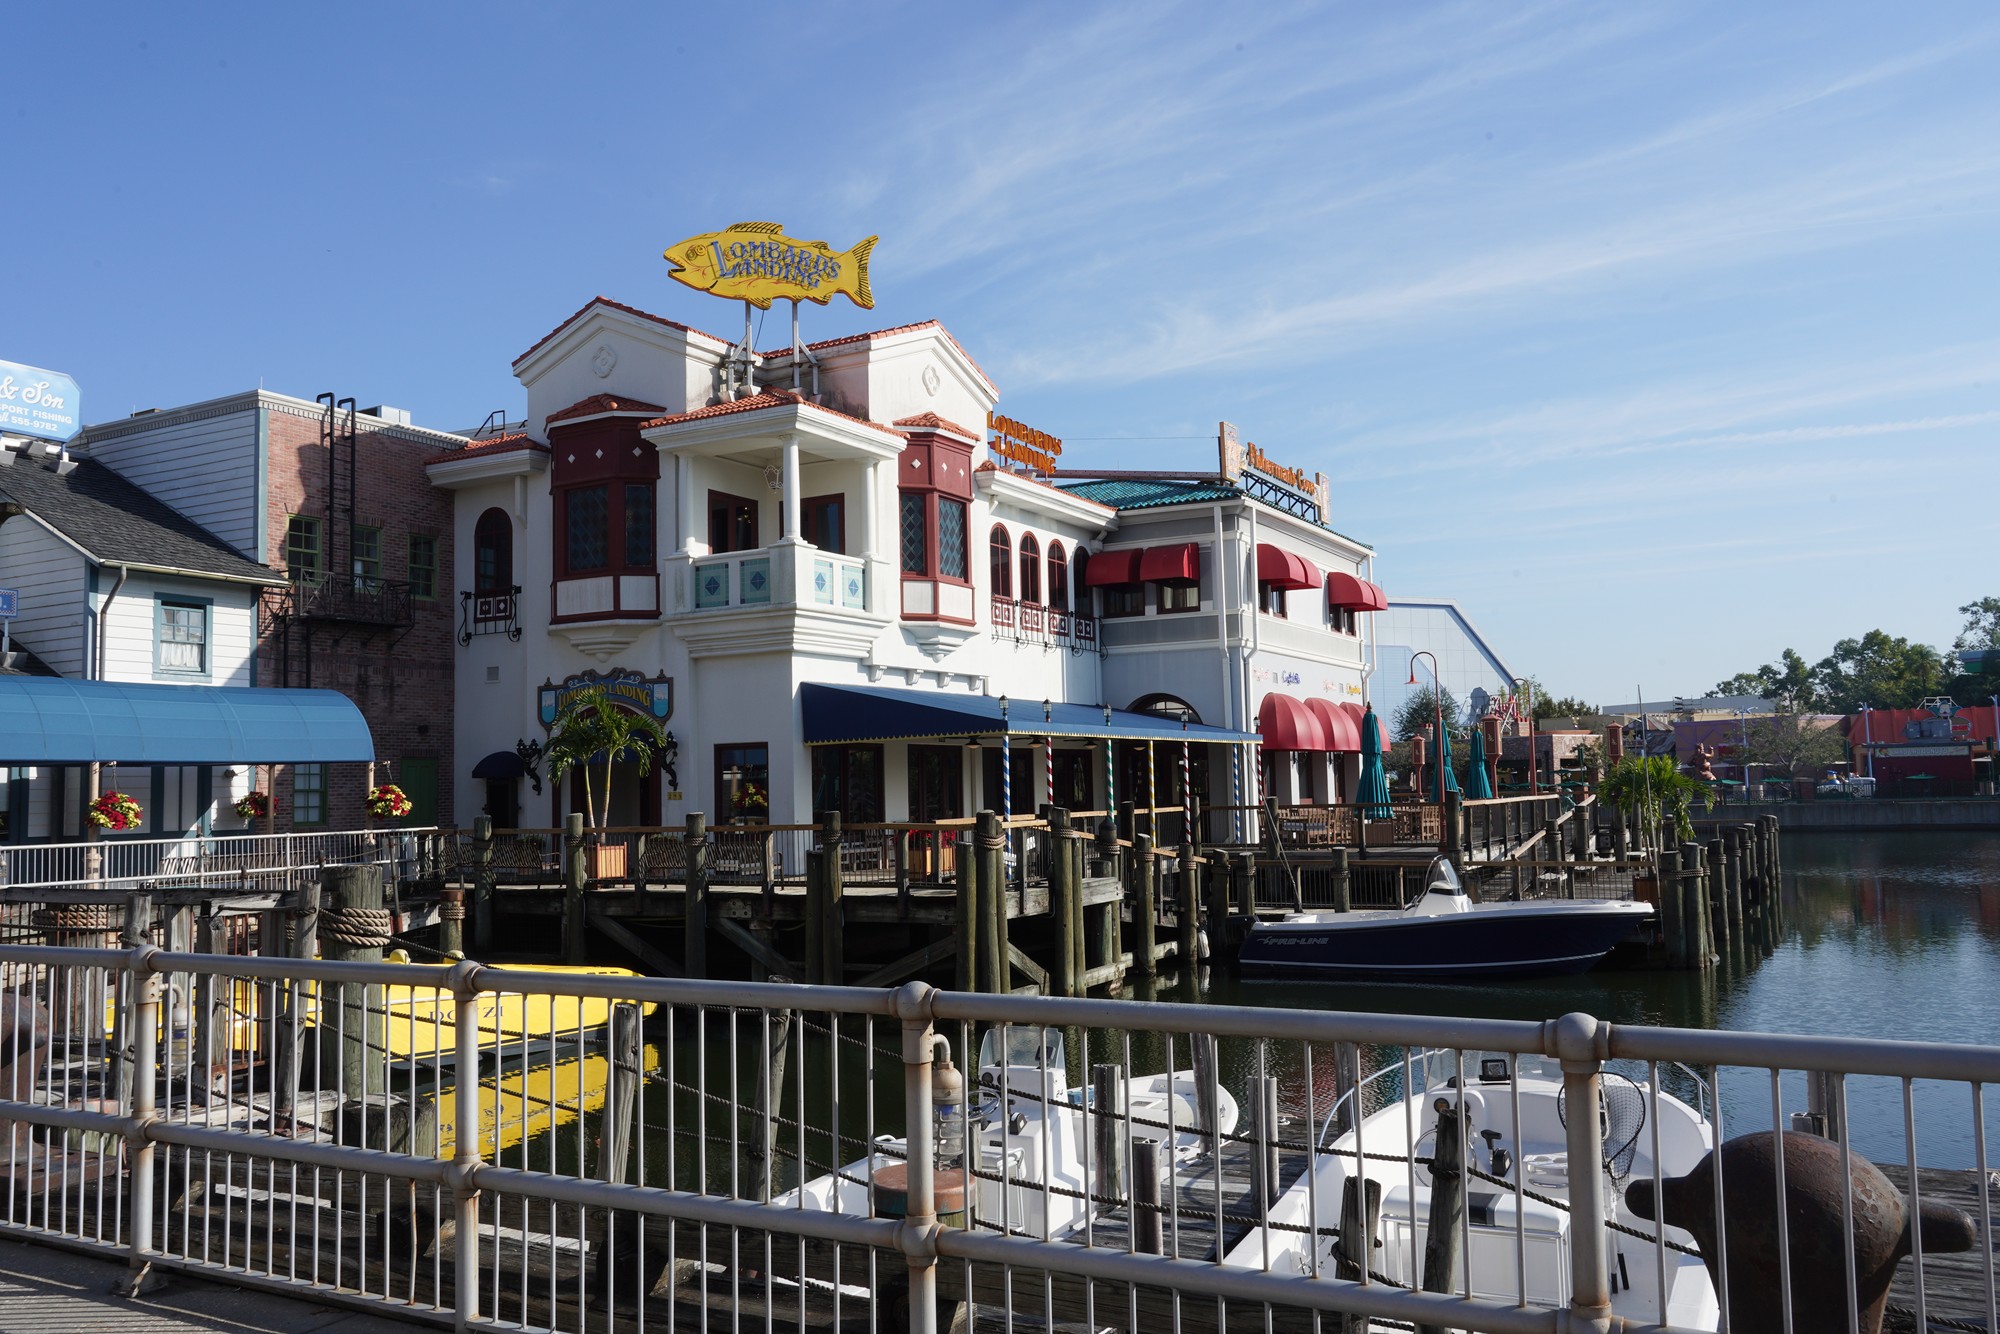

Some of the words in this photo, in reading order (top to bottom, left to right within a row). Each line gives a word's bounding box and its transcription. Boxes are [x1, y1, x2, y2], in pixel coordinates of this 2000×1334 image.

[22, 381, 64, 409] Son
[0, 403, 29, 415] PORT
[33, 410, 72, 424] FISHING
[11, 415, 58, 431] 555-9782
[994, 436, 1056, 474] LANDING
[559, 682, 606, 711] LOMD'S
[609, 684, 651, 708] LANDING
[1269, 937, 1329, 945] PRO-LINE
[429, 1006, 503, 1021] DOZI
